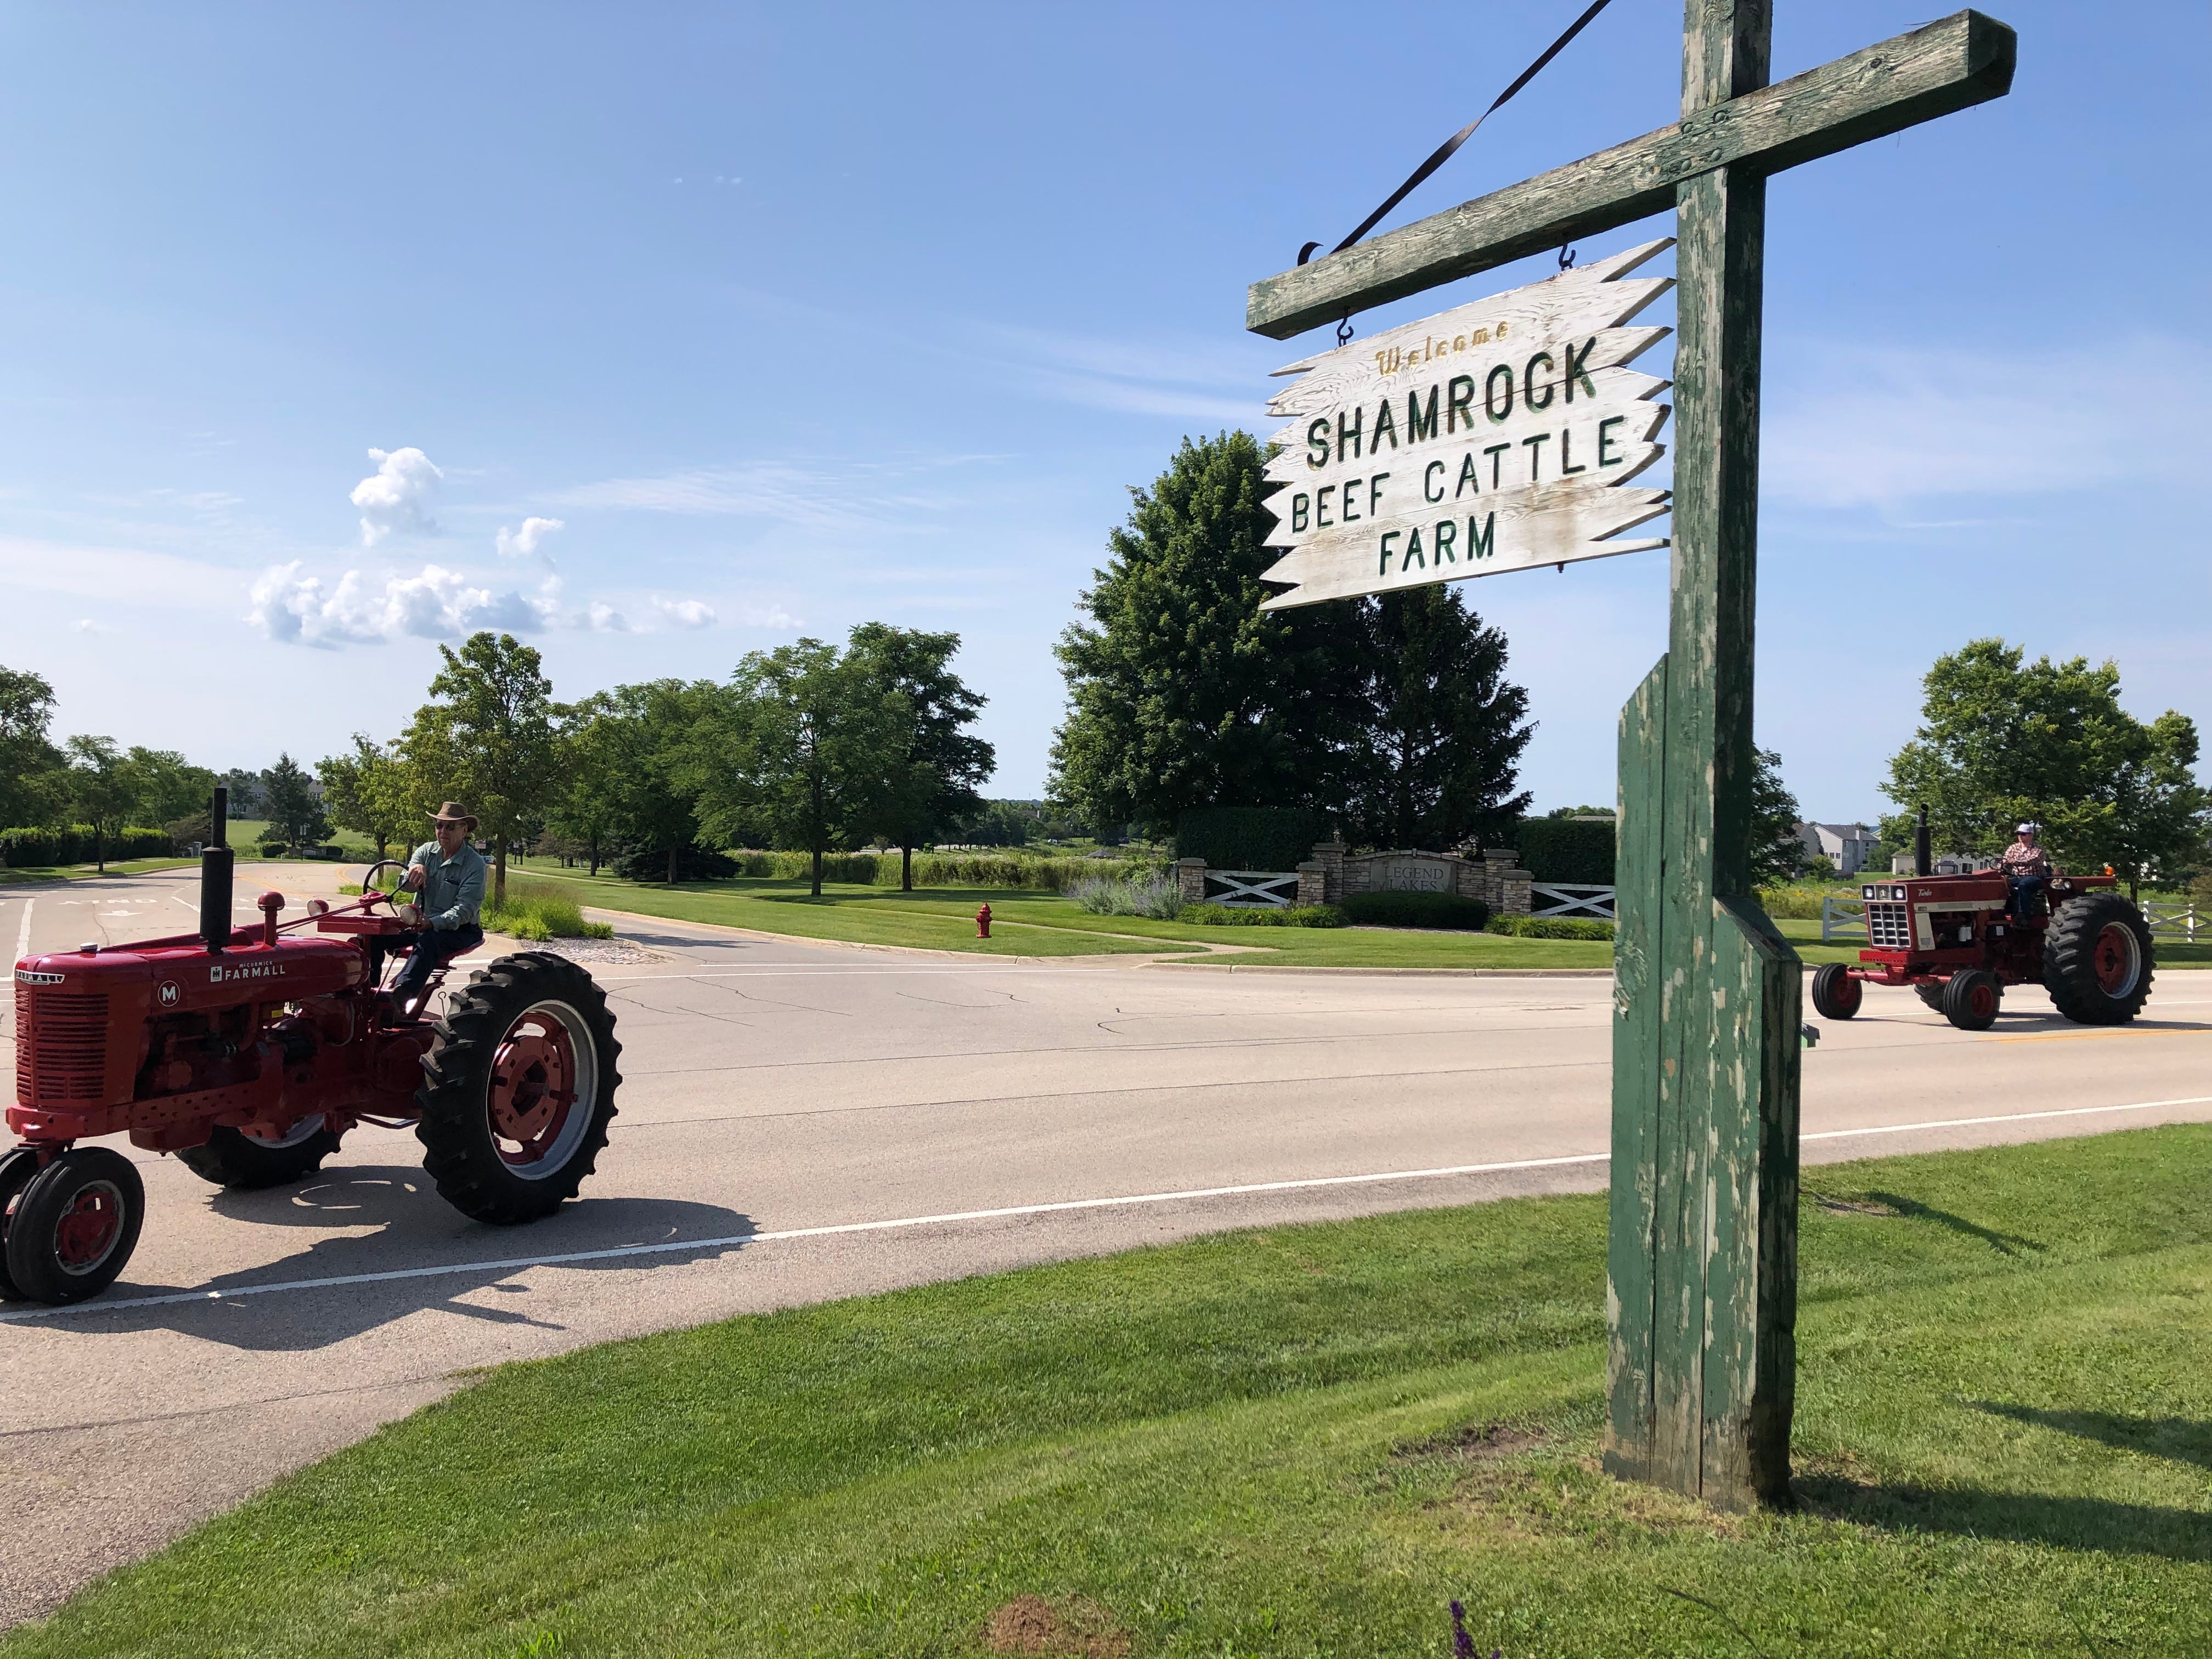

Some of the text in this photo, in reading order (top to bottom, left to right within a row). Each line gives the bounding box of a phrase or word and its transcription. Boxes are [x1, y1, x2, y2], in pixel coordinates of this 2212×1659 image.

[1375, 320, 1509, 375] Welcome
[1307, 336, 1597, 472] SHAMROCK
[1292, 415, 1627, 534] BEEF CATTLE
[1379, 511, 1494, 576] FARM
[1385, 866, 1443, 879] LEGEND
[1390, 879, 1437, 891] LAKES
[225, 964, 286, 981] FARMALL
[162, 986, 176, 1001] M
